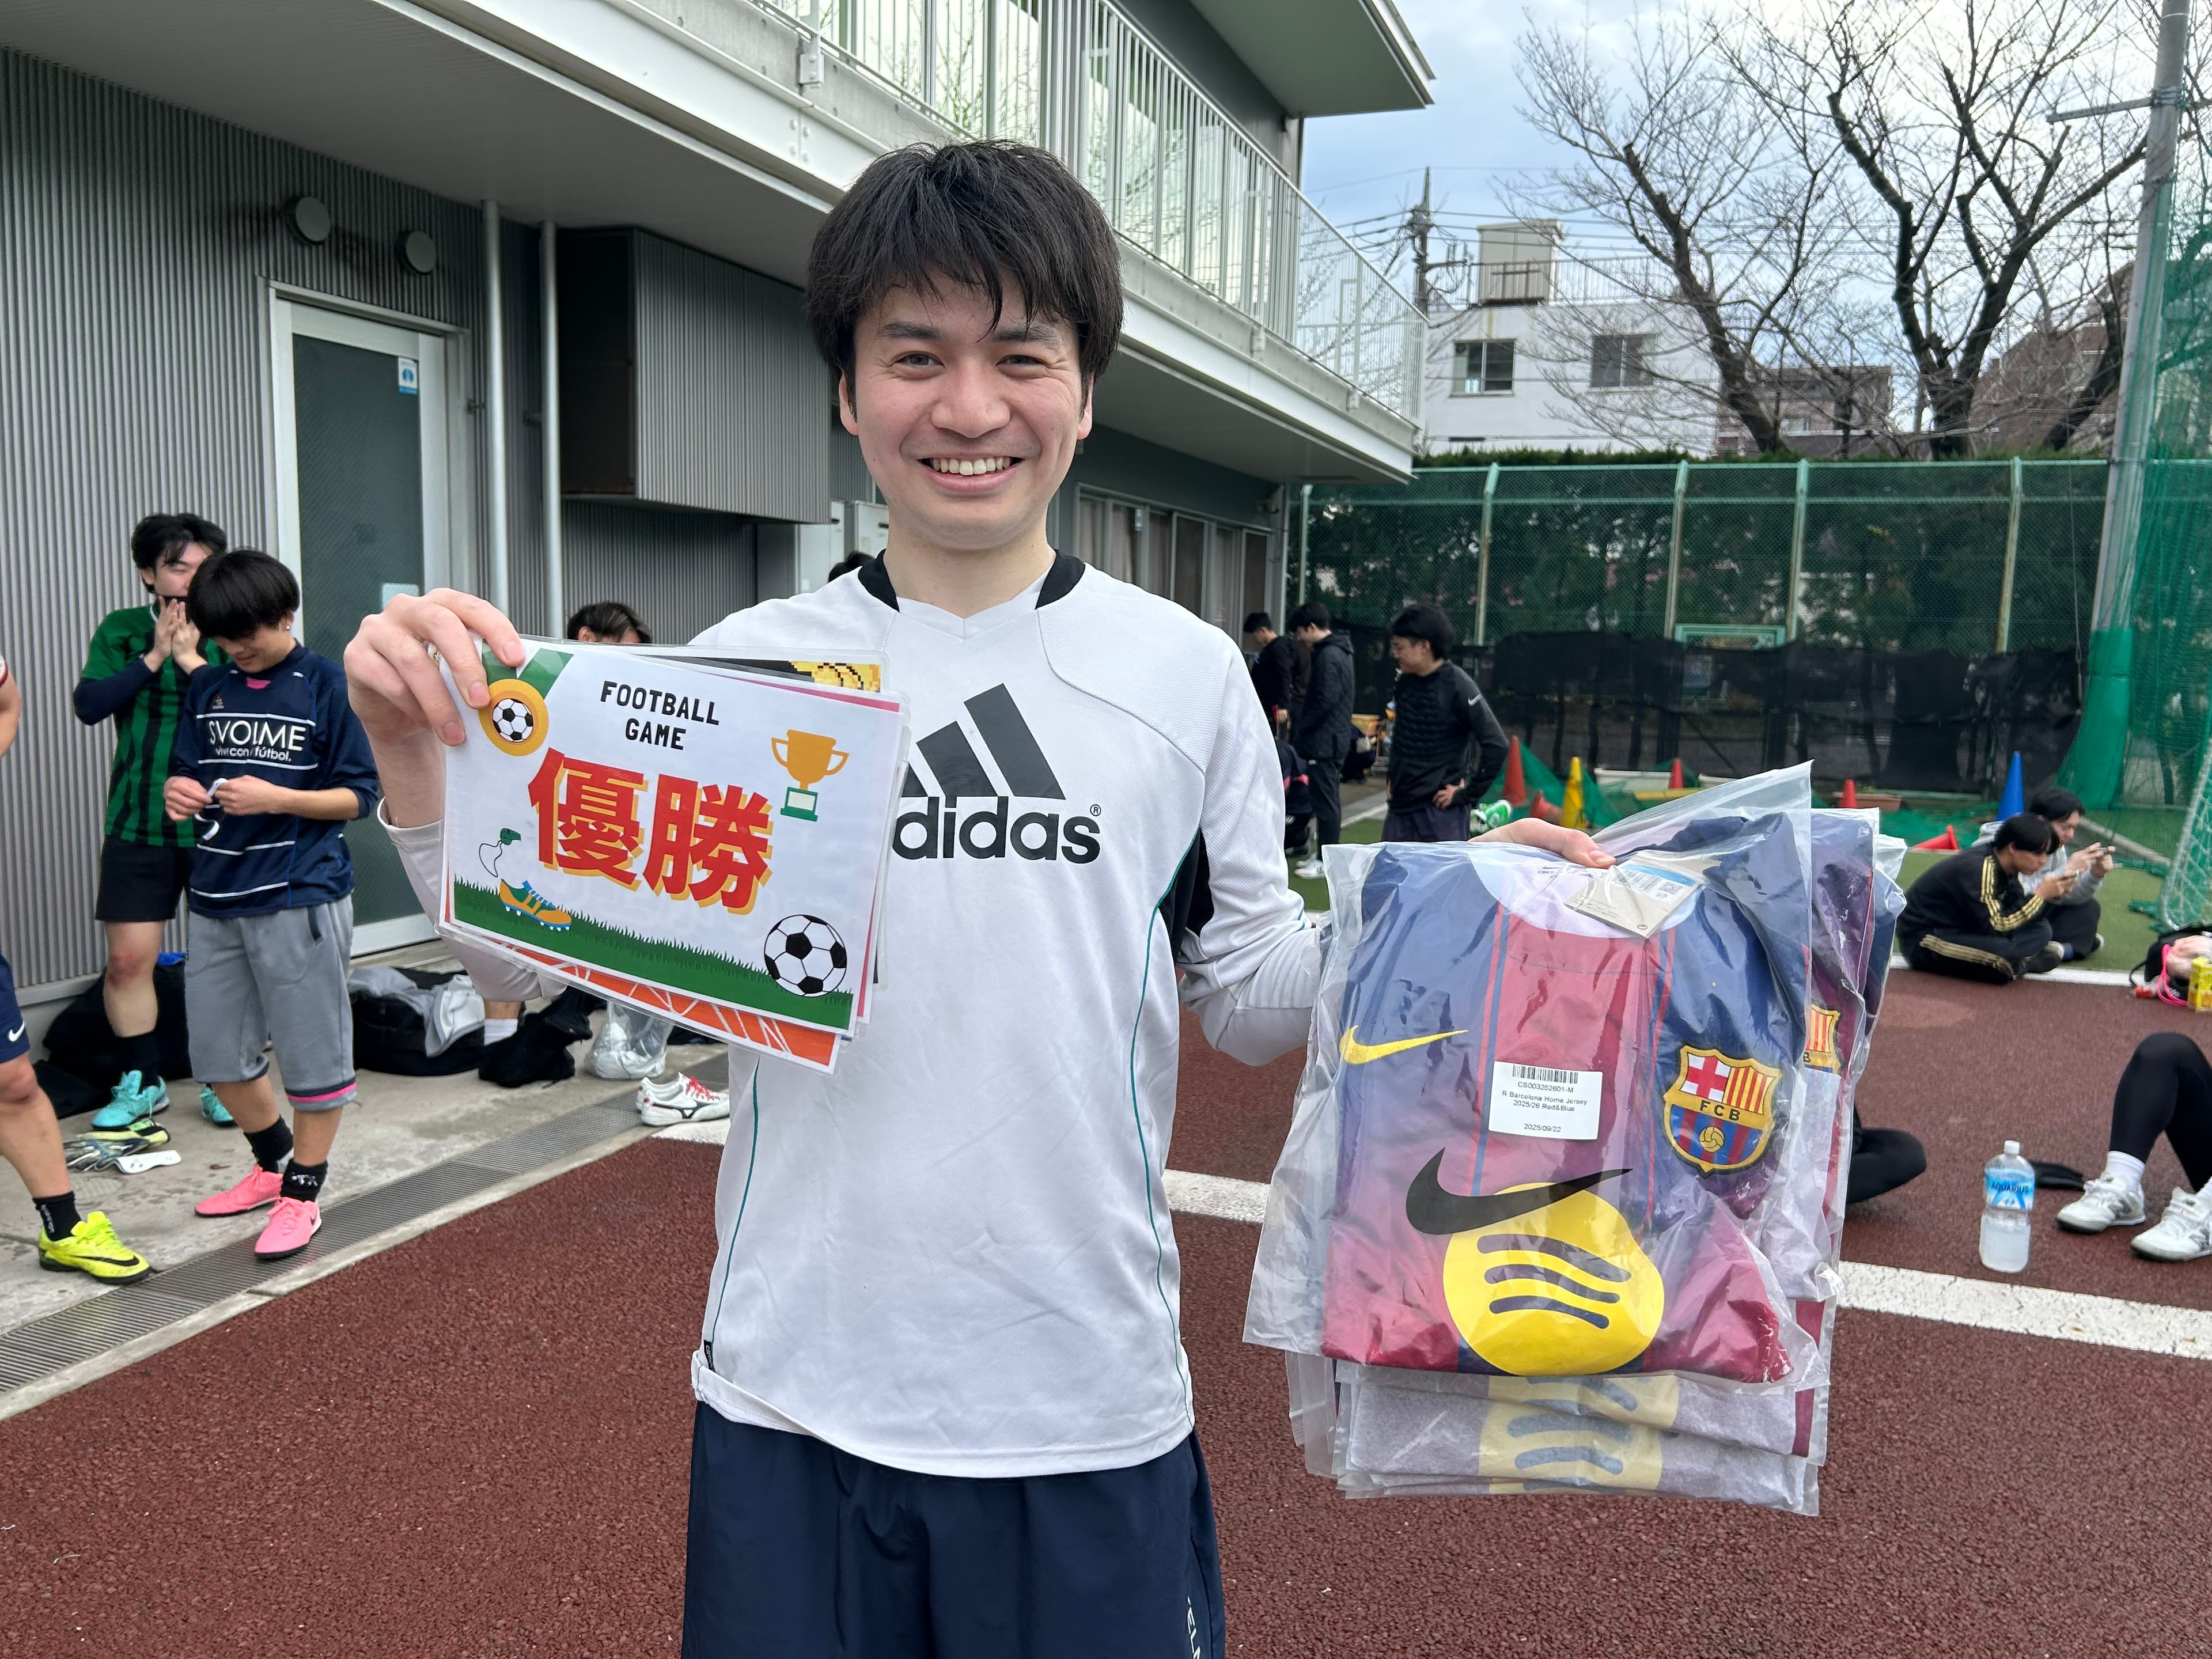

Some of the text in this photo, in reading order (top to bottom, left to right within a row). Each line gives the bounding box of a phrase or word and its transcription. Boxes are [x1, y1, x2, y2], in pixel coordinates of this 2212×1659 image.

[600, 681, 719, 726] FOOTBALL
[625, 718, 687, 751] GAME
[528, 747, 773, 915] 優勝
[1518, 1082, 1574, 1093] CS003252601-M
[1509, 1091, 1542, 1101] Barcelona
[1513, 1100, 1540, 1109] 2025/26
[1524, 1123, 1561, 1132] 2025/09/22
[1991, 1180, 2029, 1195] AQUARIUS
